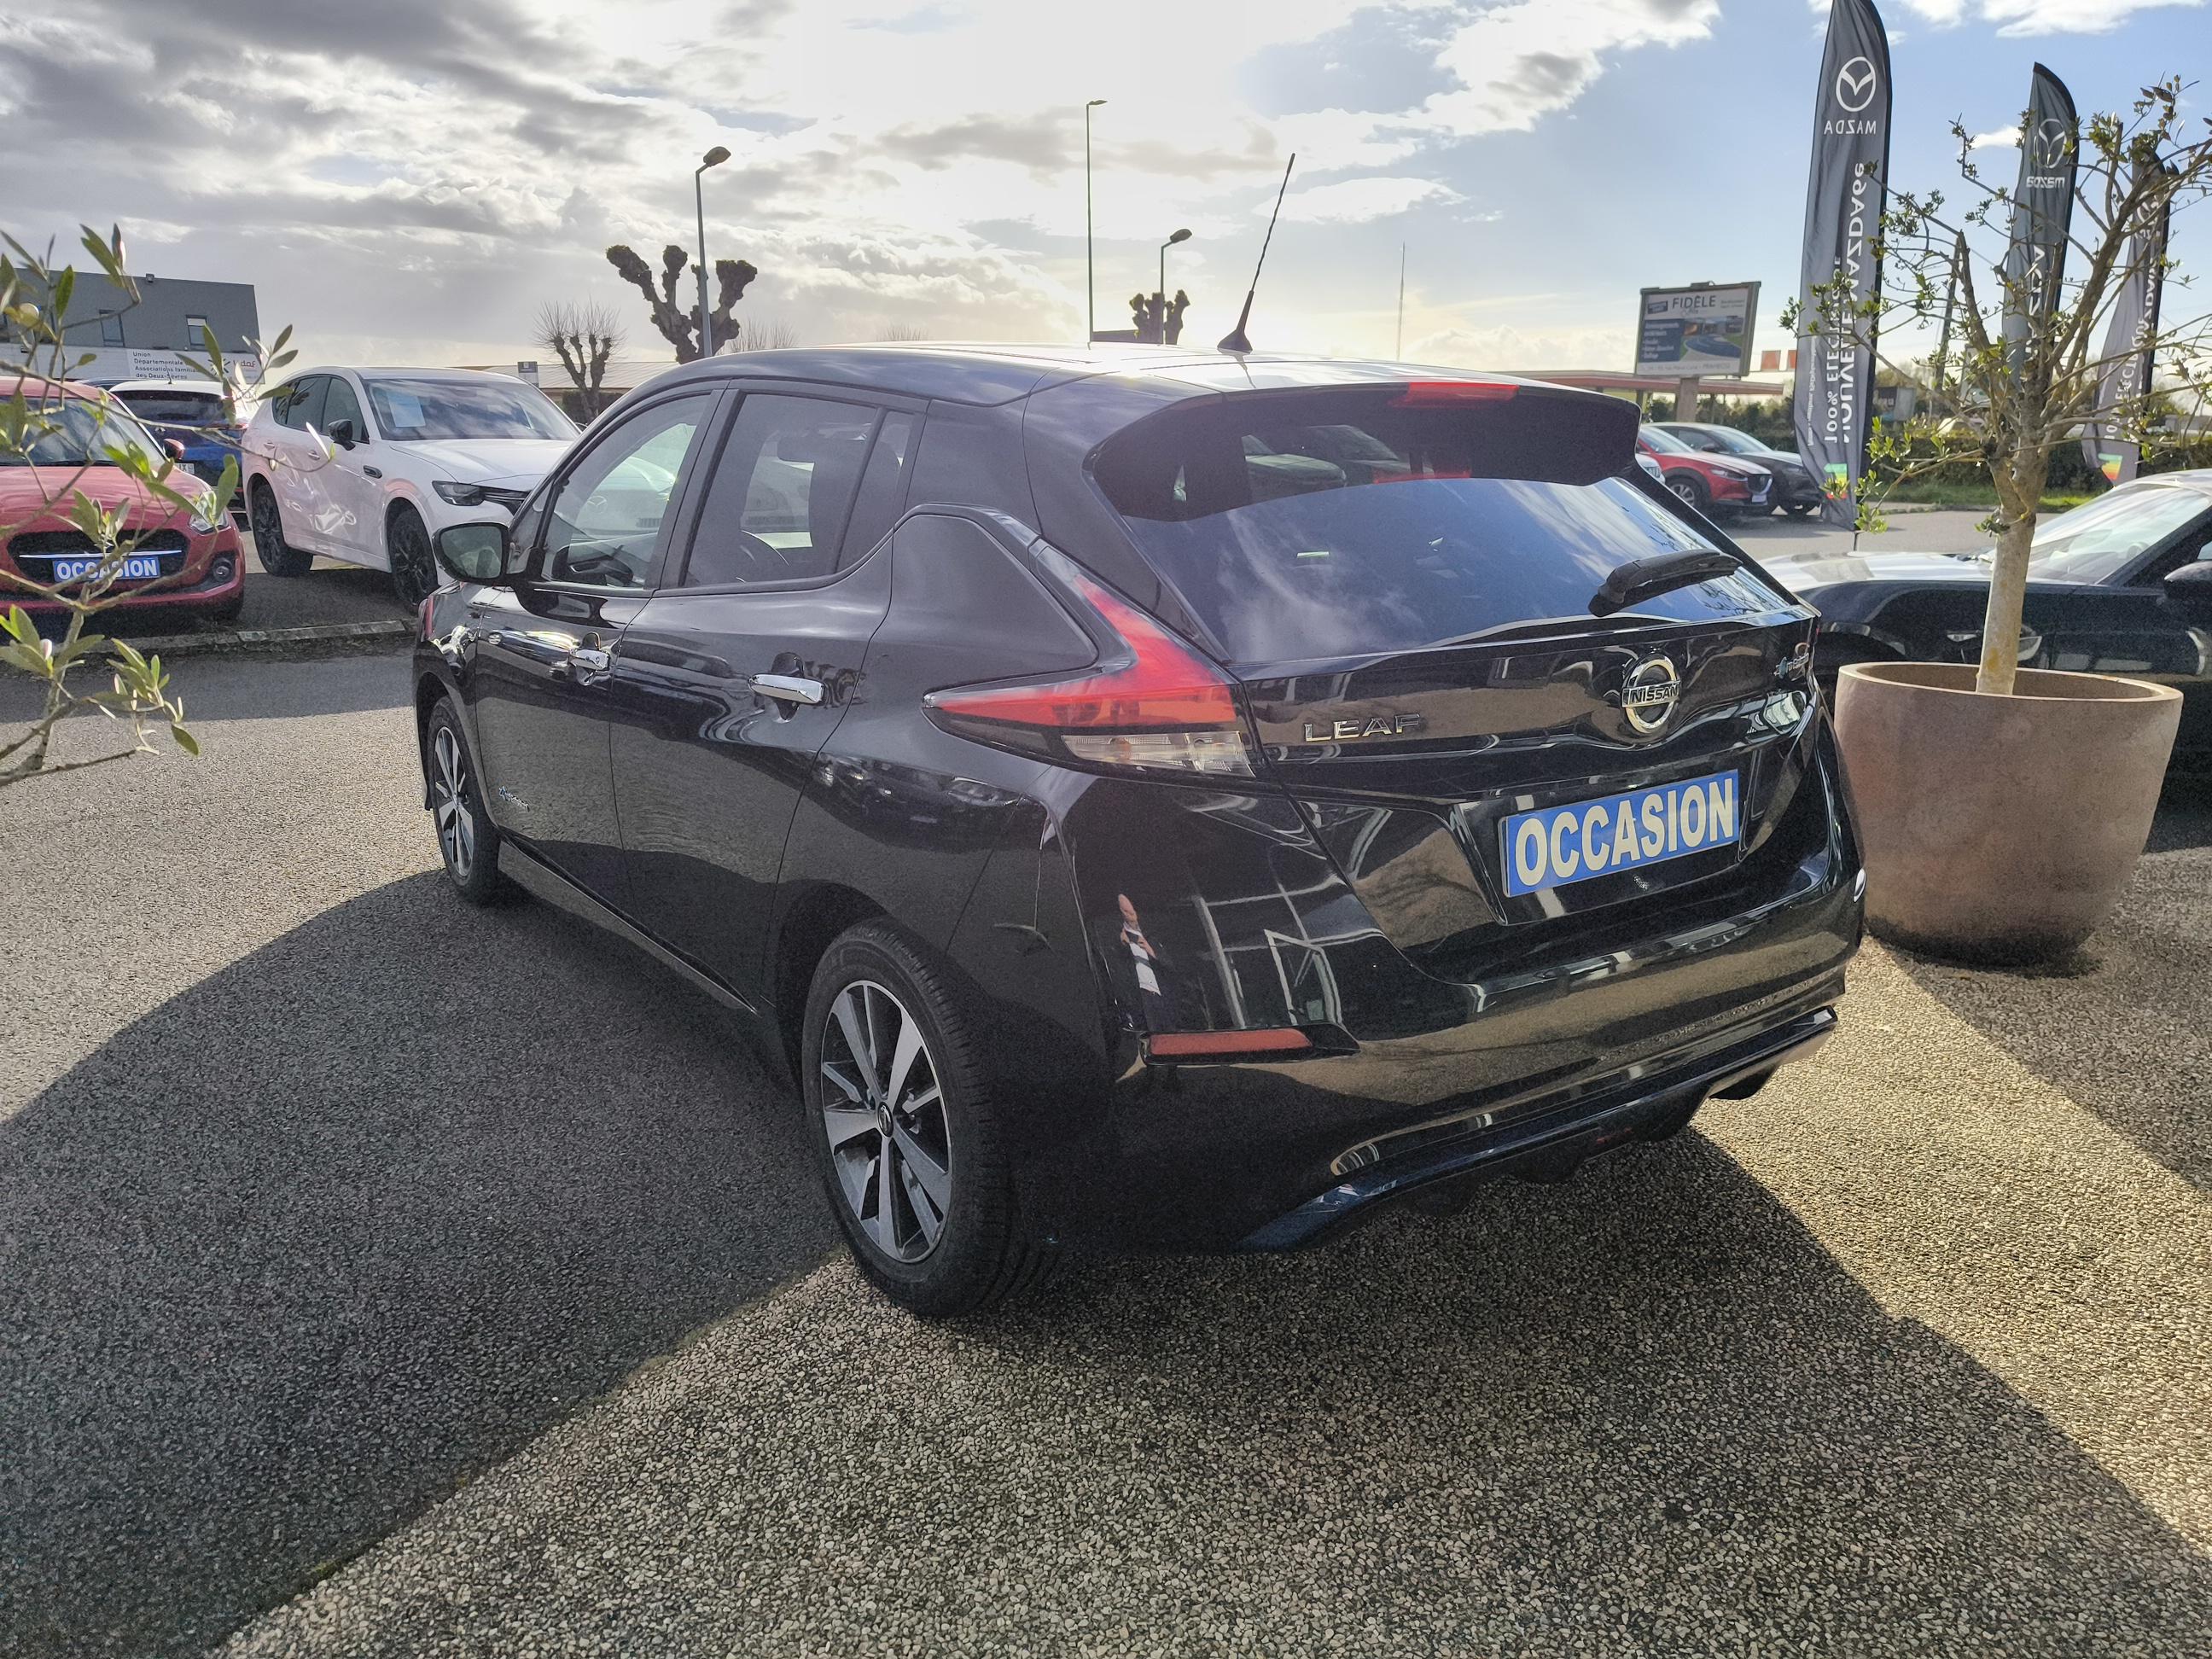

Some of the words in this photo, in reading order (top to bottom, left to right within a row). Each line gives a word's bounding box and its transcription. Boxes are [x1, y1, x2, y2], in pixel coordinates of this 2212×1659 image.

[1631, 684, 1678, 703] NISSAN
[1304, 713, 1420, 742] LEAF
[1515, 777, 1733, 886] OCCASION
